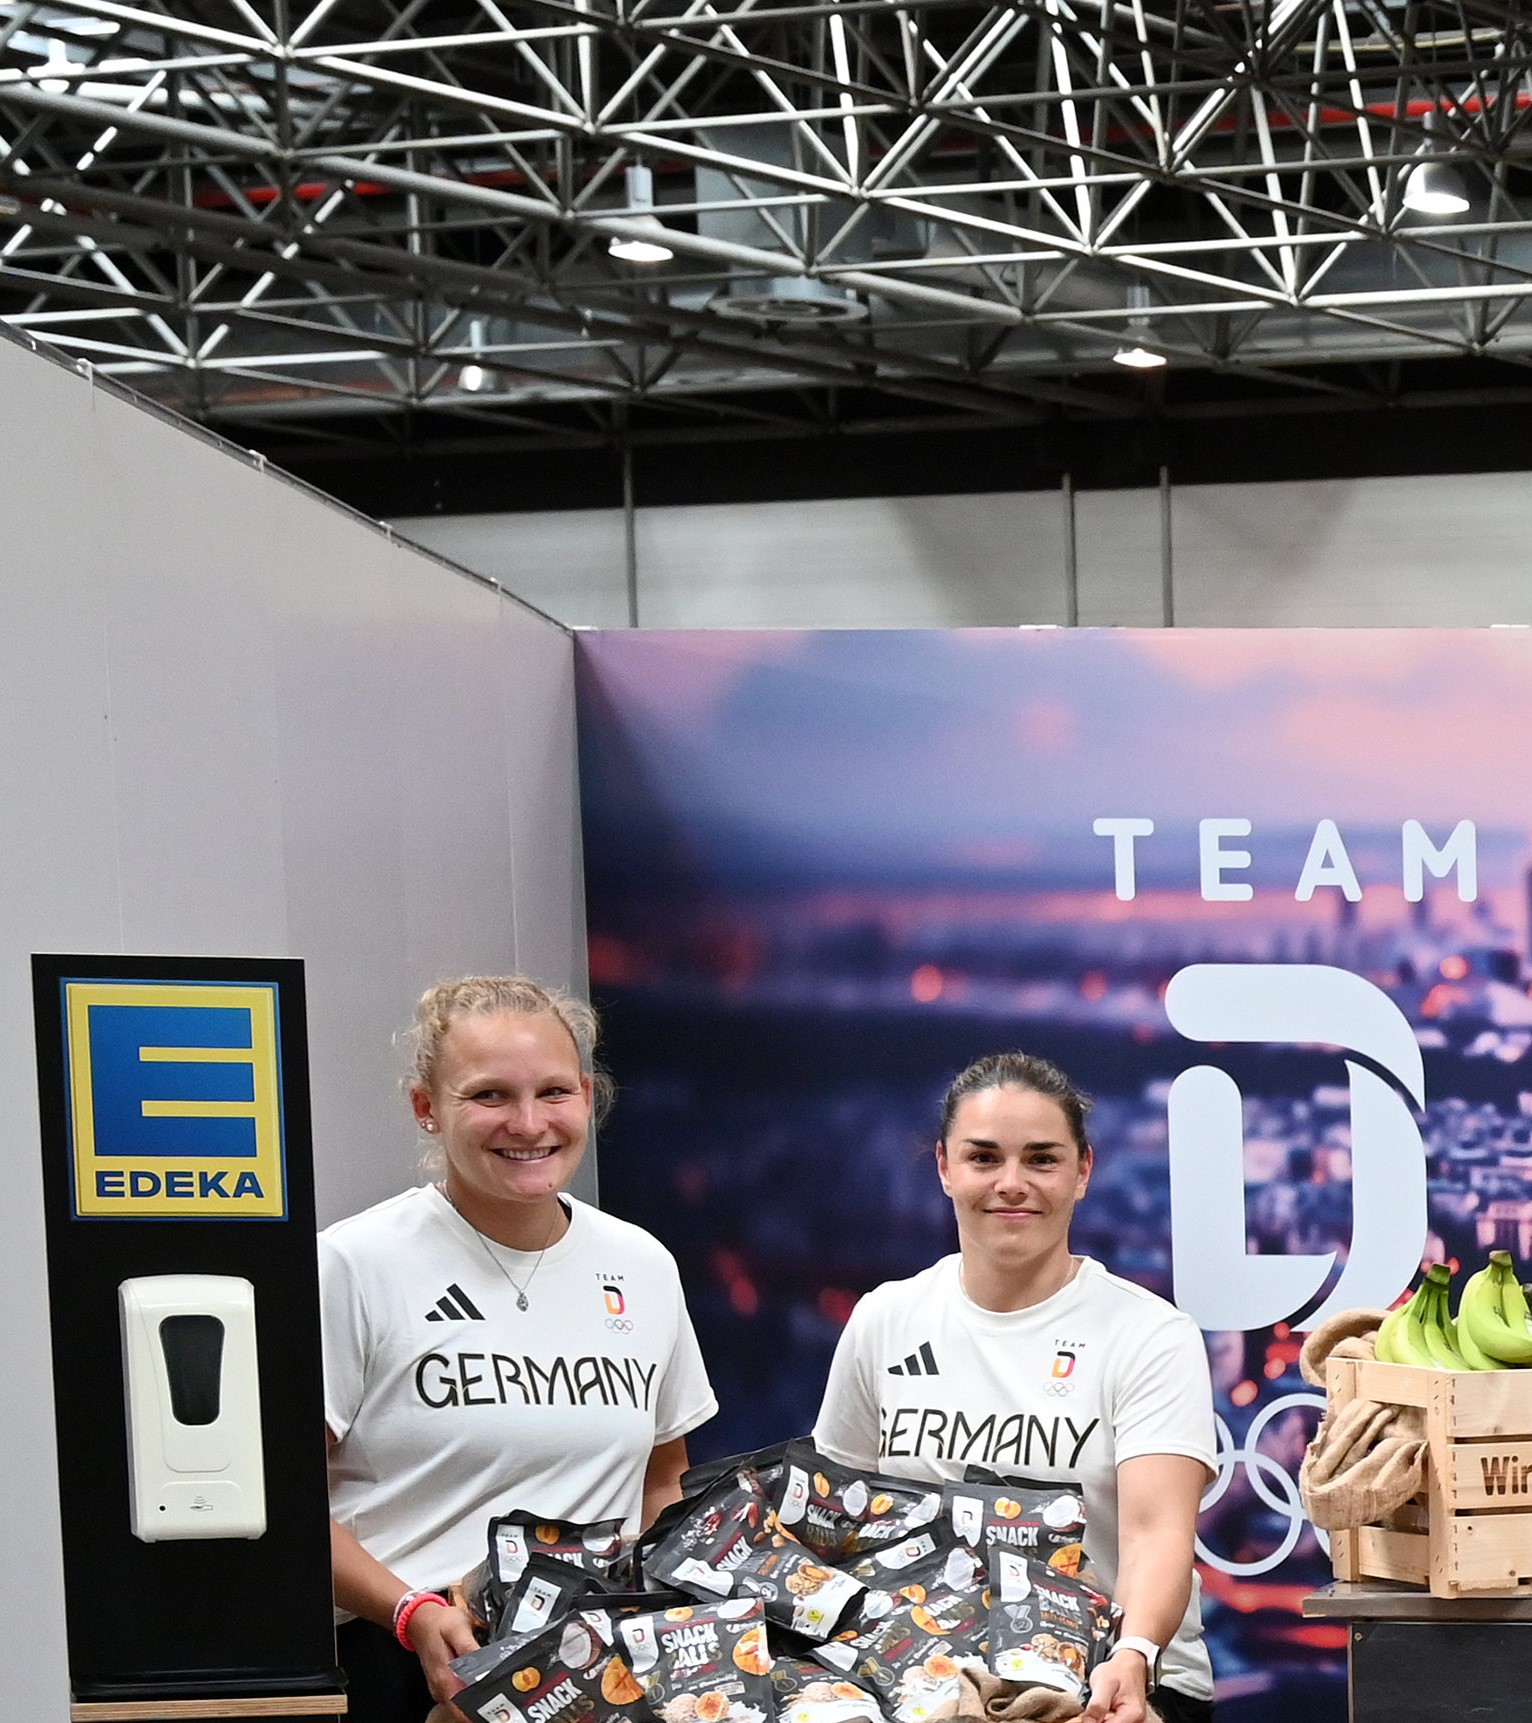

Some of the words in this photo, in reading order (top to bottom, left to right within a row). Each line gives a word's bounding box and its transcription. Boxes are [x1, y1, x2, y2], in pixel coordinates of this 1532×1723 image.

[1093, 818, 1477, 902] TEAM
[95, 1171, 264, 1199] EDEKA
[595, 1272, 625, 1282] TEAM
[415, 1352, 657, 1412] GERMANY
[807, 1503, 842, 1530] SNACK
[985, 1524, 1039, 1547] SNACK
[661, 1621, 719, 1654] SNACK
